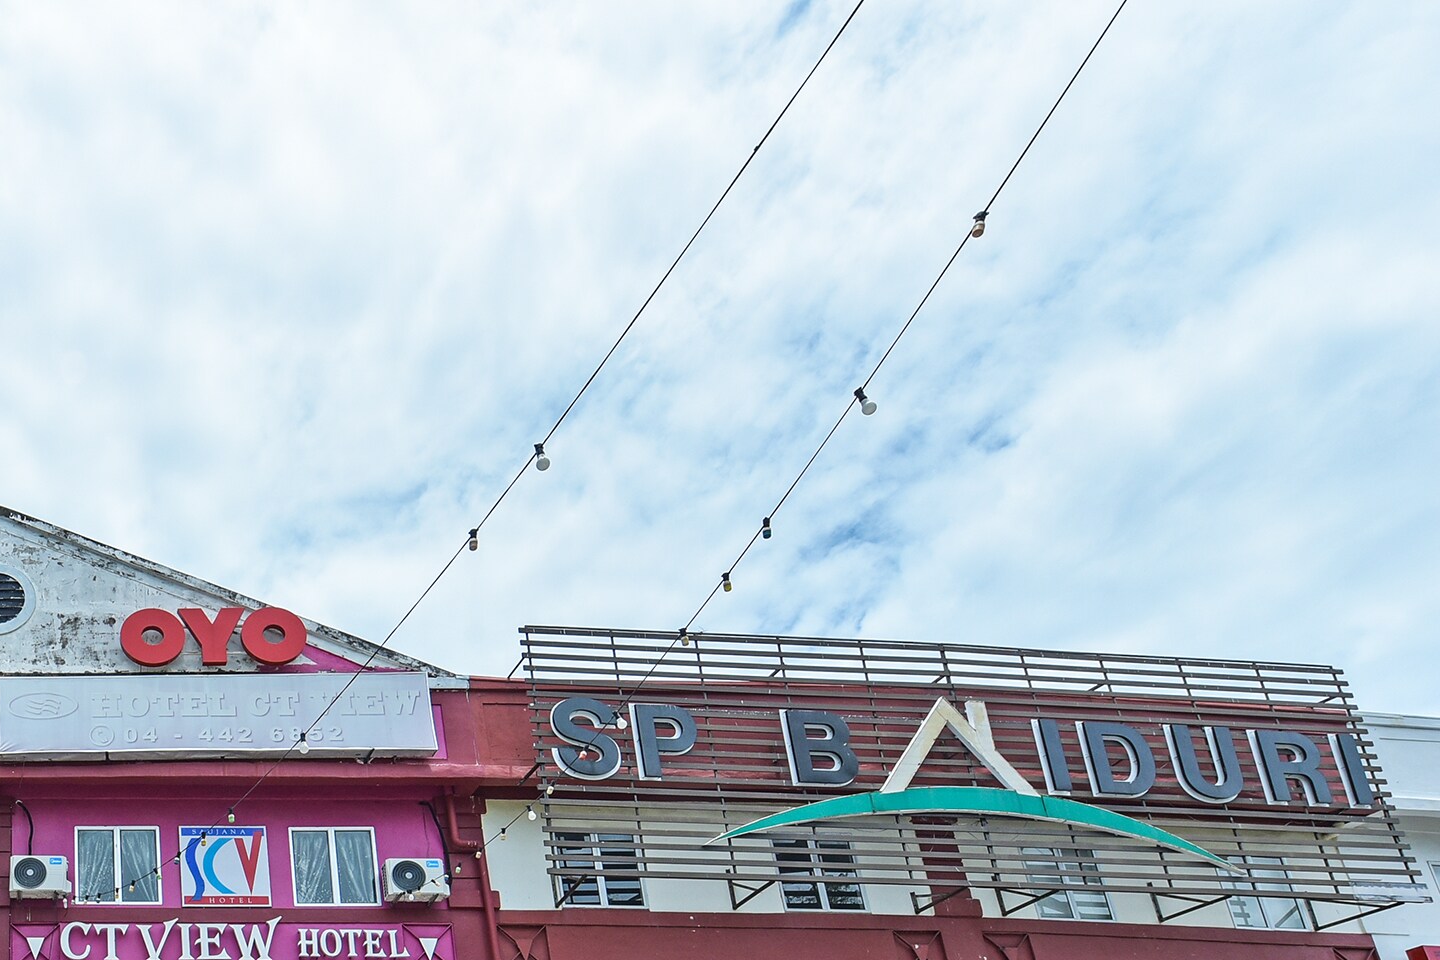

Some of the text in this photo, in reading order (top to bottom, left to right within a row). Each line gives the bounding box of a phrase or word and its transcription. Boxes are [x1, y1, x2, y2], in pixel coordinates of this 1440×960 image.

[120, 606, 308, 668] OYO
[91, 689, 421, 718] HOTEL CT VIEW
[123, 726, 159, 743] 04
[198, 726, 254, 743] 442
[270, 725, 345, 743] 6852
[549, 696, 698, 782] SP
[296, 927, 411, 959] HOTEL
